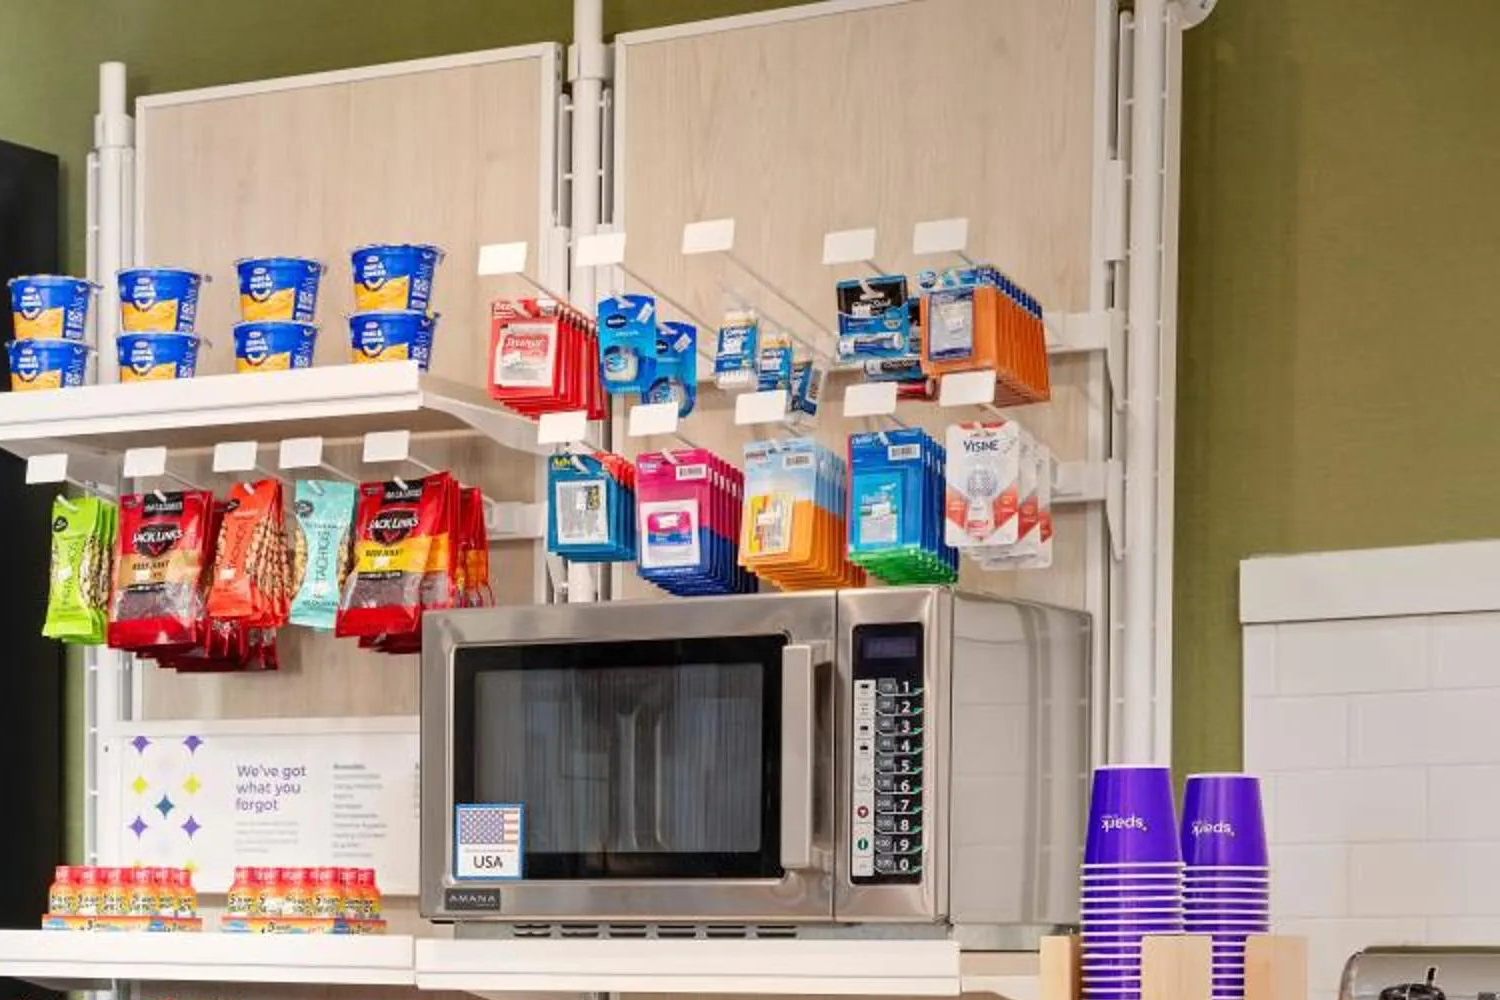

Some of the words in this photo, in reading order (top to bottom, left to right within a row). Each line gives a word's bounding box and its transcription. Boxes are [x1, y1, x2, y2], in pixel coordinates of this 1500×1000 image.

[963, 440, 999, 452] VISINE
[902, 681, 910, 693] 1
[901, 701, 911, 714] 2
[901, 720, 910, 733] 3
[901, 740, 910, 753] 4
[236, 763, 279, 777] We've
[282, 765, 307, 780] got
[901, 760, 909, 772] 5
[236, 781, 272, 794] what
[274, 783, 301, 796] you
[901, 780, 910, 793] 6
[235, 797, 279, 813] forgot
[901, 799, 909, 812] 7
[900, 819, 909, 832] 8
[900, 839, 909, 851] 9
[473, 855, 504, 869] USA
[900, 859, 909, 871] 0
[449, 894, 497, 903] AMANA
